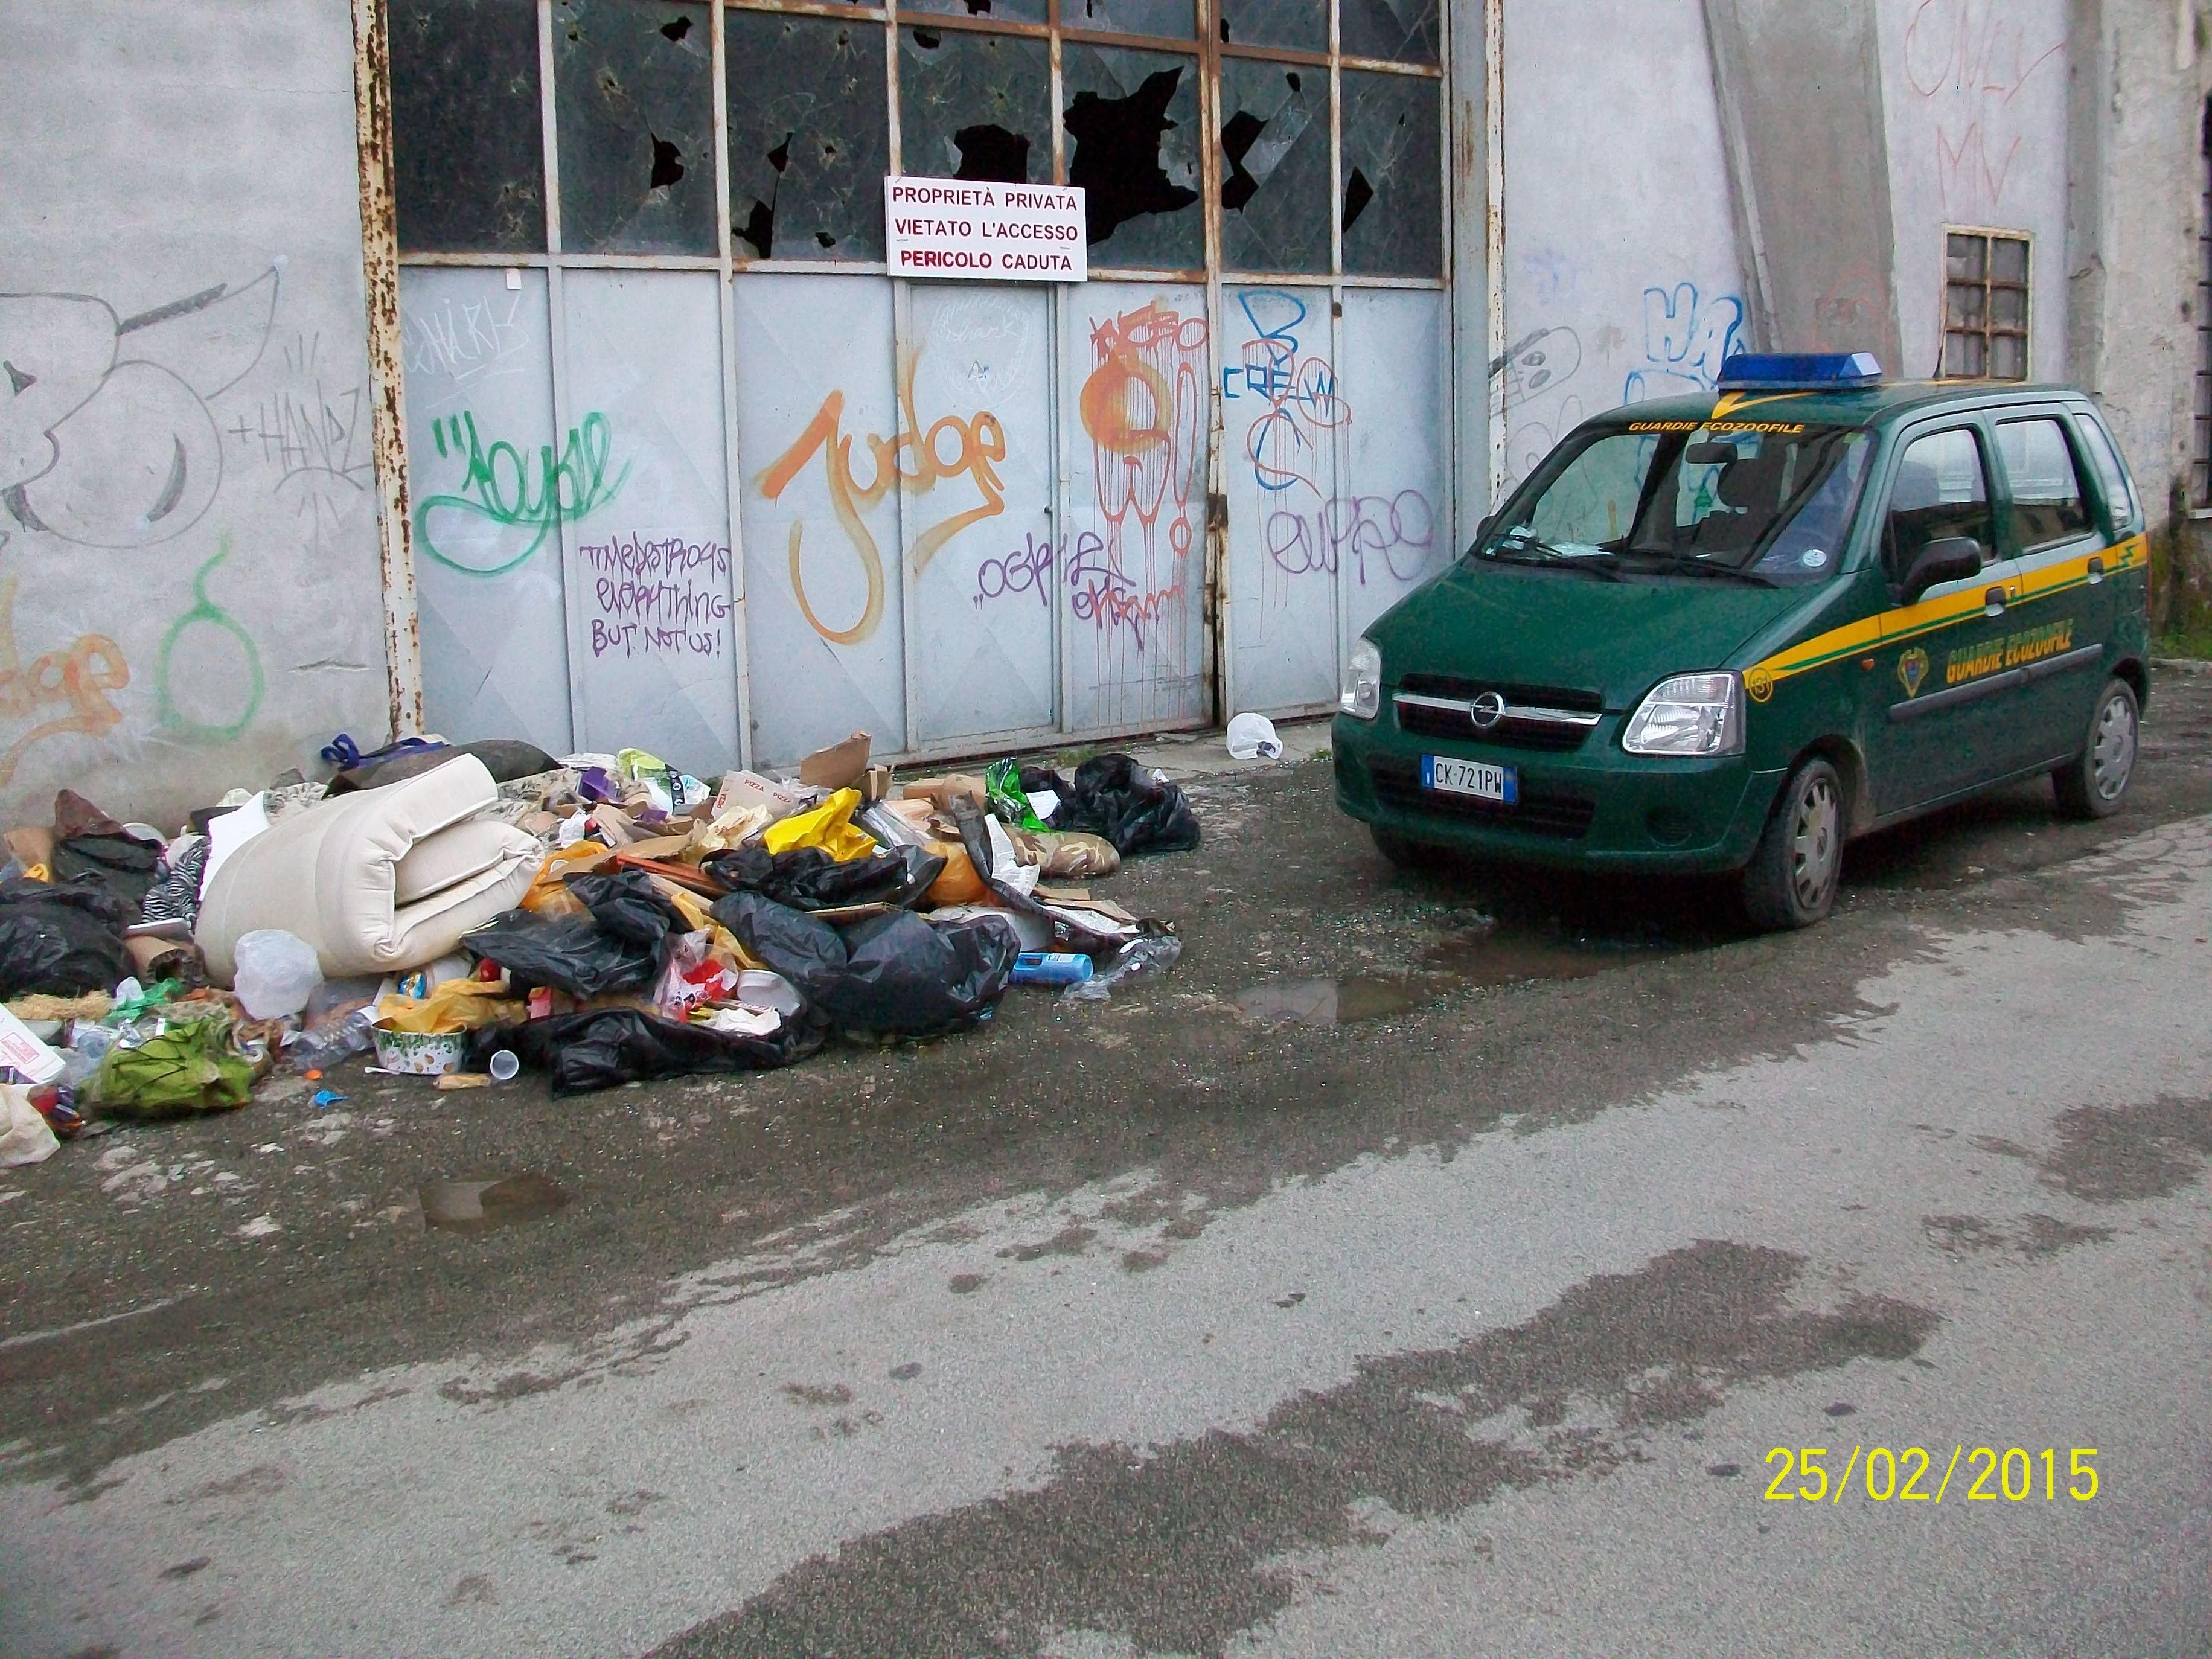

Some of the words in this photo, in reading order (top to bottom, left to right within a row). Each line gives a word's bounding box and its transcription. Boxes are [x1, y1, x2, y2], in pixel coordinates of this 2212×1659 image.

[893, 186, 995, 206] PROPRIETÀ
[1005, 193, 1078, 211] PRIVATA
[895, 218, 971, 237] VIETATO
[982, 222, 1078, 241] L'ACCESSO
[901, 249, 993, 269] PERICOLO
[1002, 254, 1072, 270] CADUTA
[1629, 421, 1698, 432] GUARDIE
[1699, 422, 1806, 433] ECOZOOFILE
[744, 779, 764, 792] PIZZA
